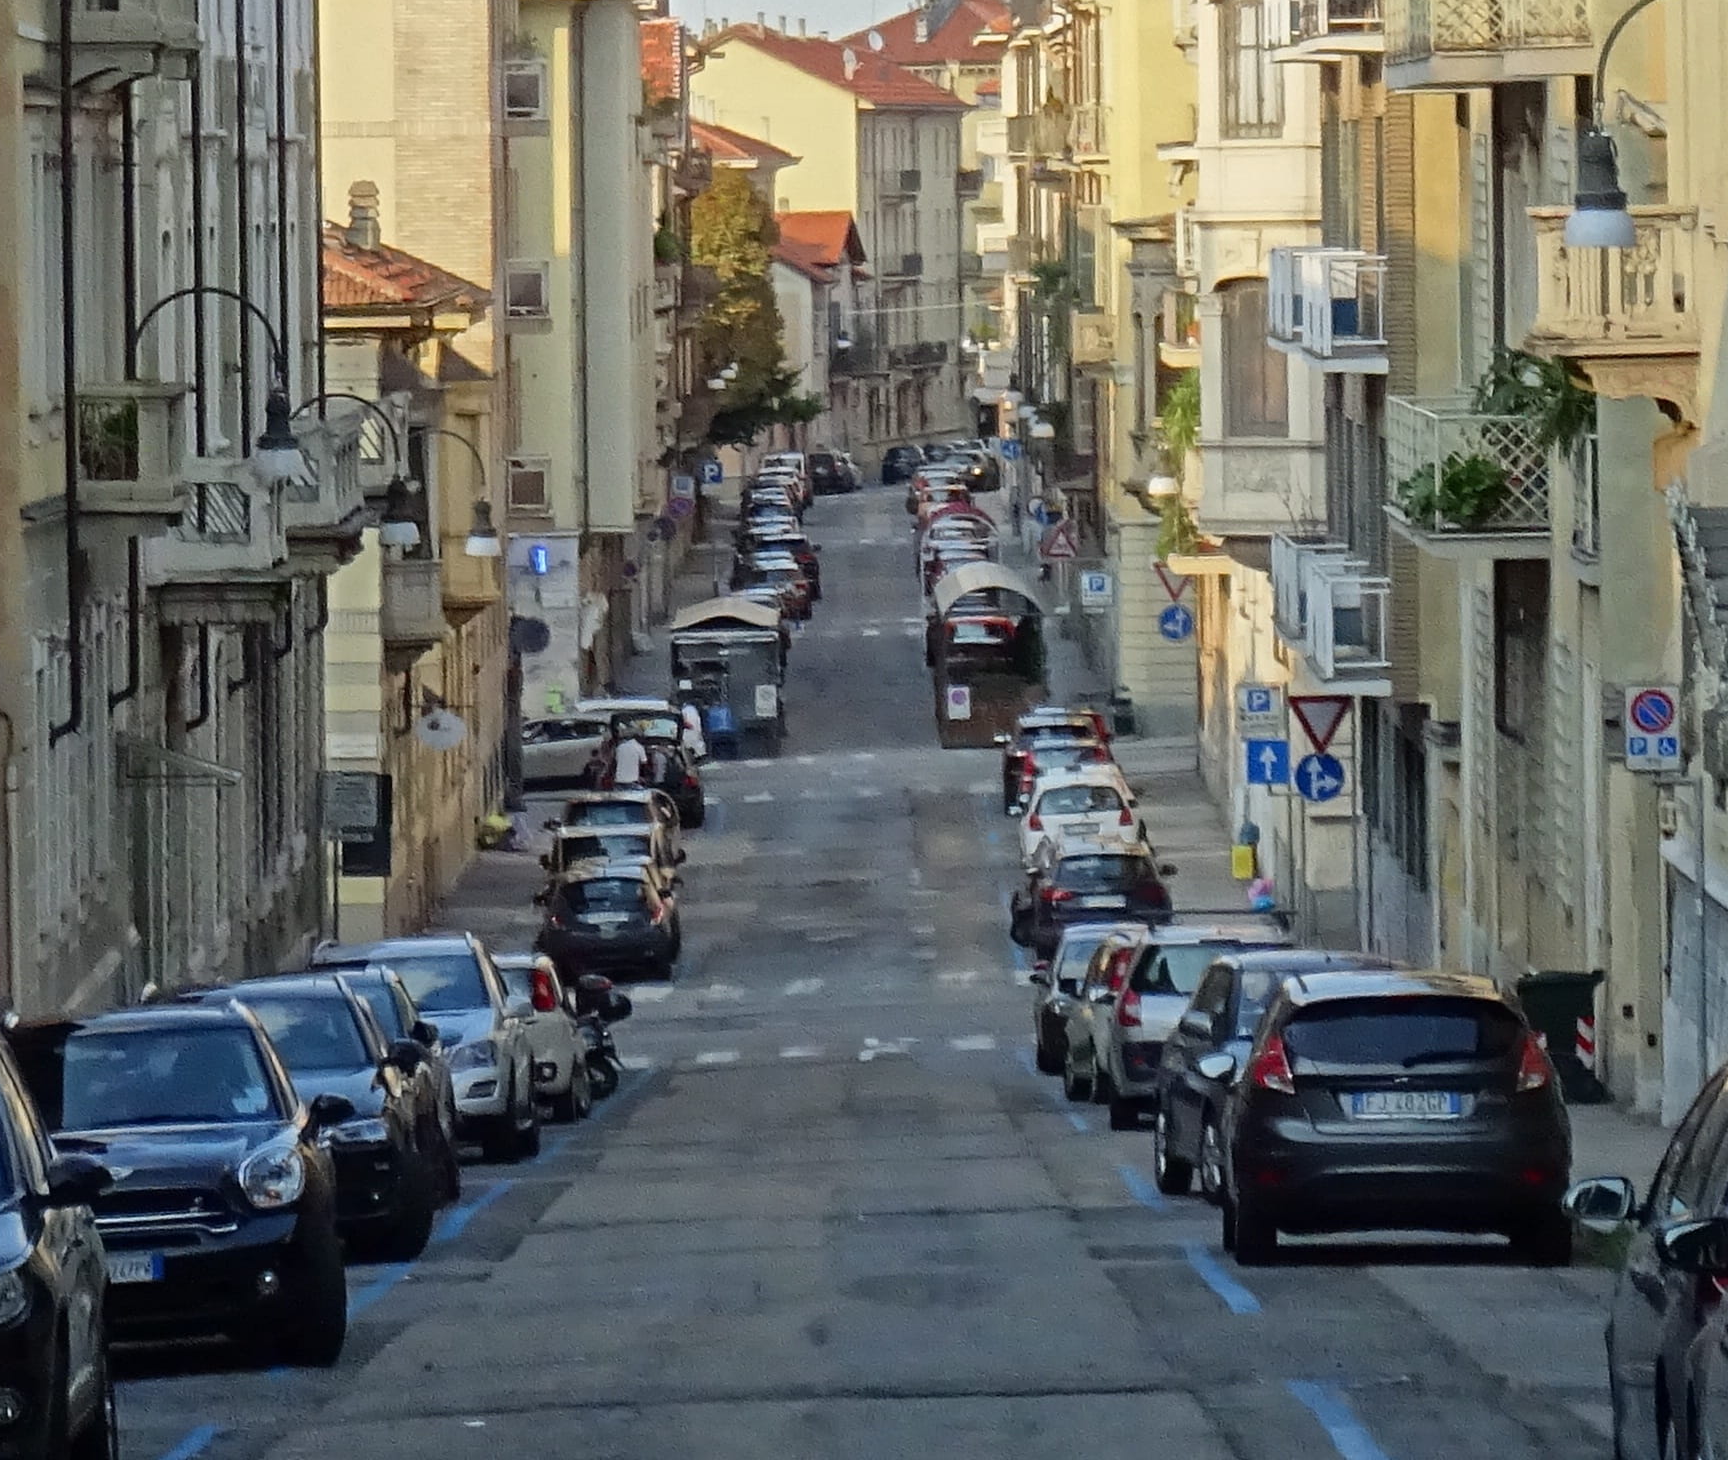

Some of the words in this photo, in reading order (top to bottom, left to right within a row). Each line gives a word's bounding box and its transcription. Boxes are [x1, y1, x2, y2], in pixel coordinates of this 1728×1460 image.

[704, 464, 719, 482] P
[1252, 692, 1267, 710] P
[1632, 738, 1645, 755] P
